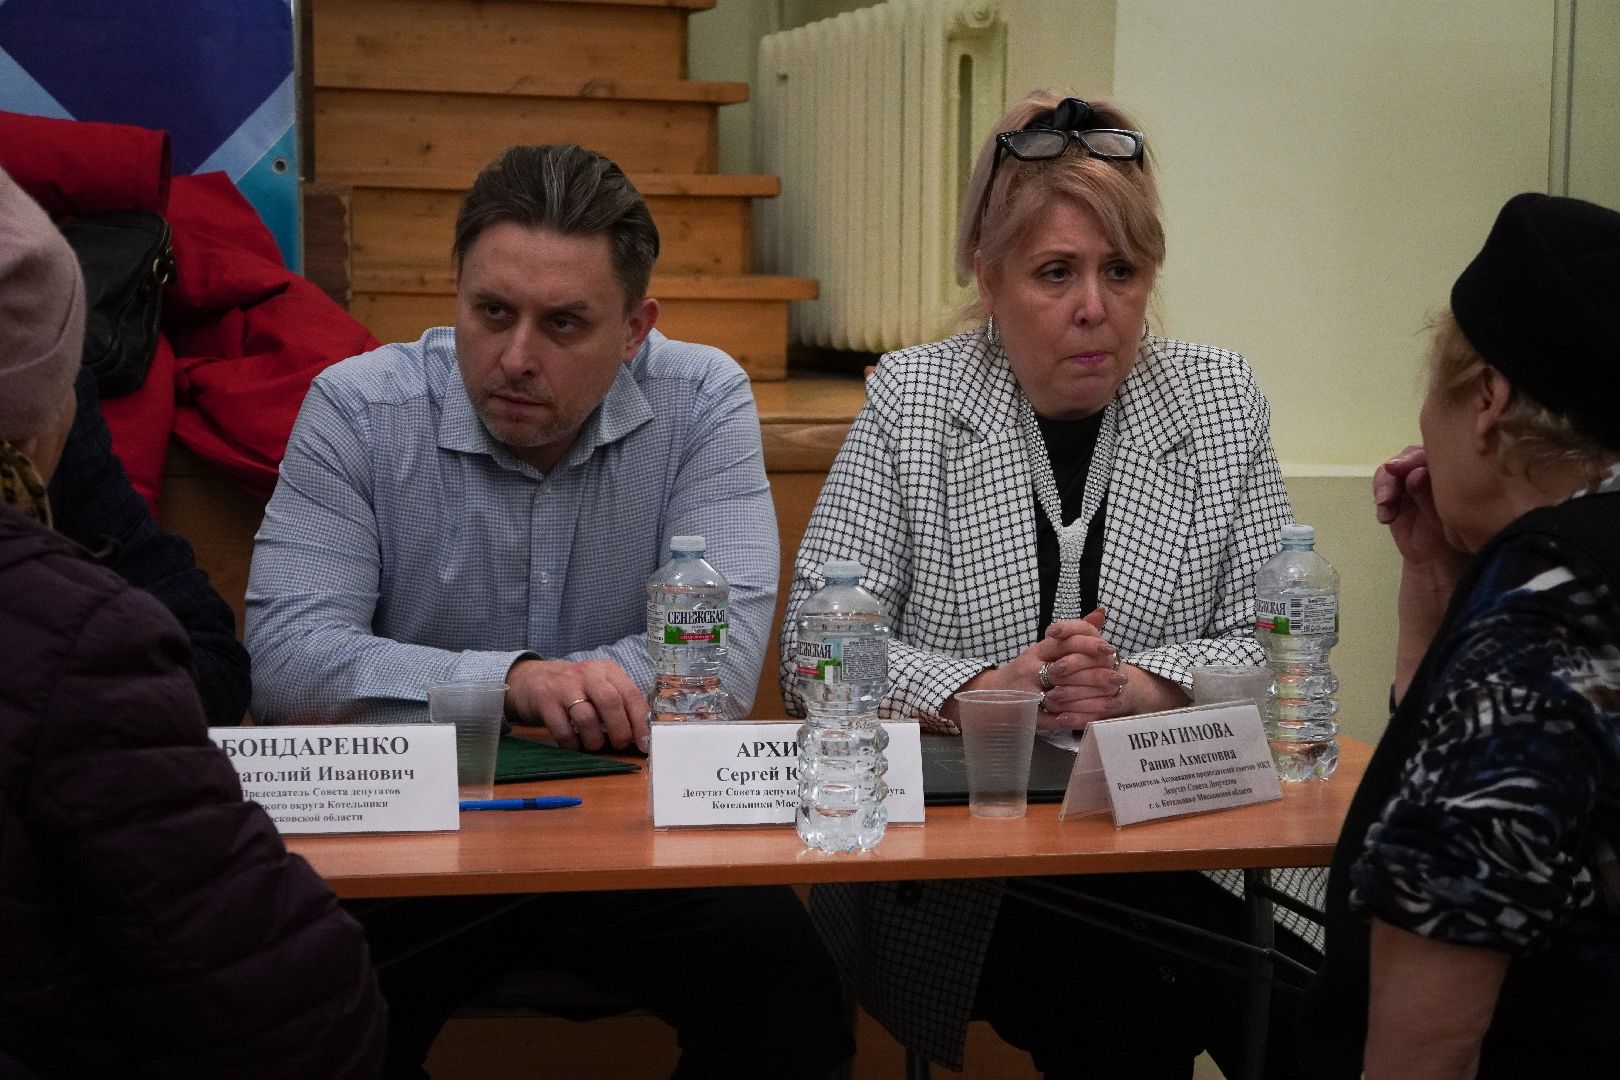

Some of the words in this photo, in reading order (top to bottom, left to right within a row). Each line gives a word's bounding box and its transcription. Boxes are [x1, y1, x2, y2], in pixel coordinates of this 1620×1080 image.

[667, 609, 725, 624] СЕНЕЖСКАЯ
[798, 641, 832, 659] ЕЖСКАЯ
[1128, 722, 1234, 750] ИБРАГИМОВА
[221, 736, 409, 759] БОНДАРЕНКО
[737, 741, 799, 758] АРХИ
[1140, 757, 1176, 773] Рания
[1179, 749, 1237, 767] Ахметовна
[239, 766, 311, 783] атолий
[317, 765, 415, 781] Иванович
[716, 766, 779, 785] Сергей
[682, 788, 723, 799] Депутат
[725, 787, 761, 797] Совета
[762, 788, 797, 798] депута
[1117, 779, 1160, 791] Руководитель
[1163, 786, 1187, 796] Депутат
[1187, 783, 1208, 791] Совета
[242, 788, 310, 800] Председатель
[312, 787, 348, 797] Совета
[350, 788, 401, 798] депутатов
[1161, 796, 1196, 807] Котельники
[1196, 789, 1232, 801] Московской
[290, 802, 324, 812] округа
[327, 800, 388, 810] Котельники
[711, 799, 773, 809] Котельники
[323, 813, 363, 822] области
